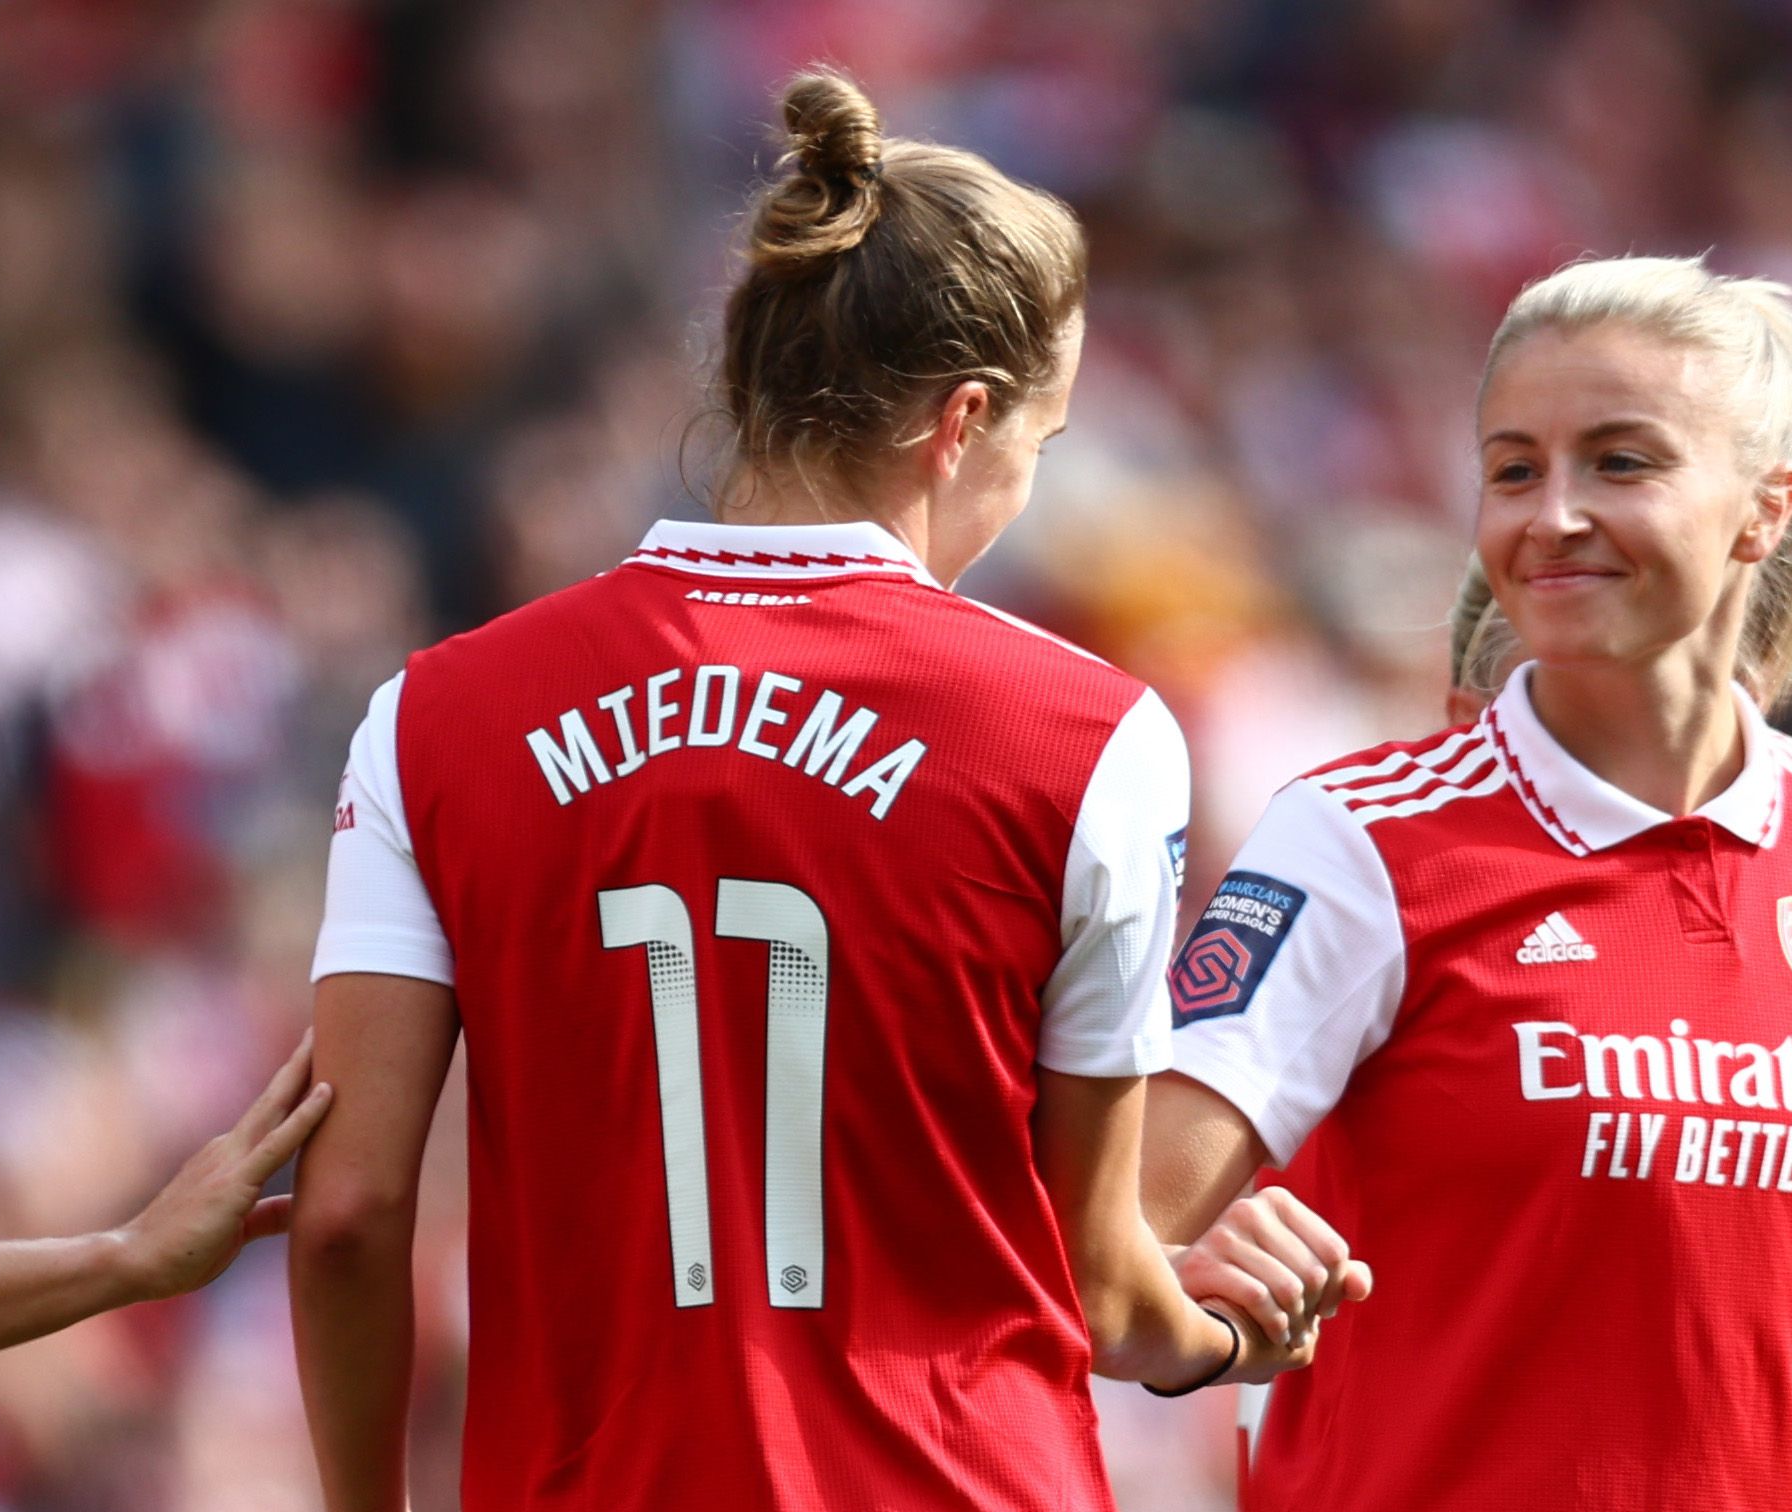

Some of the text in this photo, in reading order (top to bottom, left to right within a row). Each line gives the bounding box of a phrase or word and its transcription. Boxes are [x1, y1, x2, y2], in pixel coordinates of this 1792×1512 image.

[684, 589, 812, 606] ARSENAL
[526, 664, 926, 820] MIEDEMA
[1227, 881, 1292, 909] BARCLAYS
[1208, 895, 1283, 925] WOMEN'S
[1229, 911, 1277, 937] LEAGUE
[1516, 943, 1597, 965] adidas
[598, 878, 829, 1309] 11
[1581, 1112, 1665, 1181] FLY
